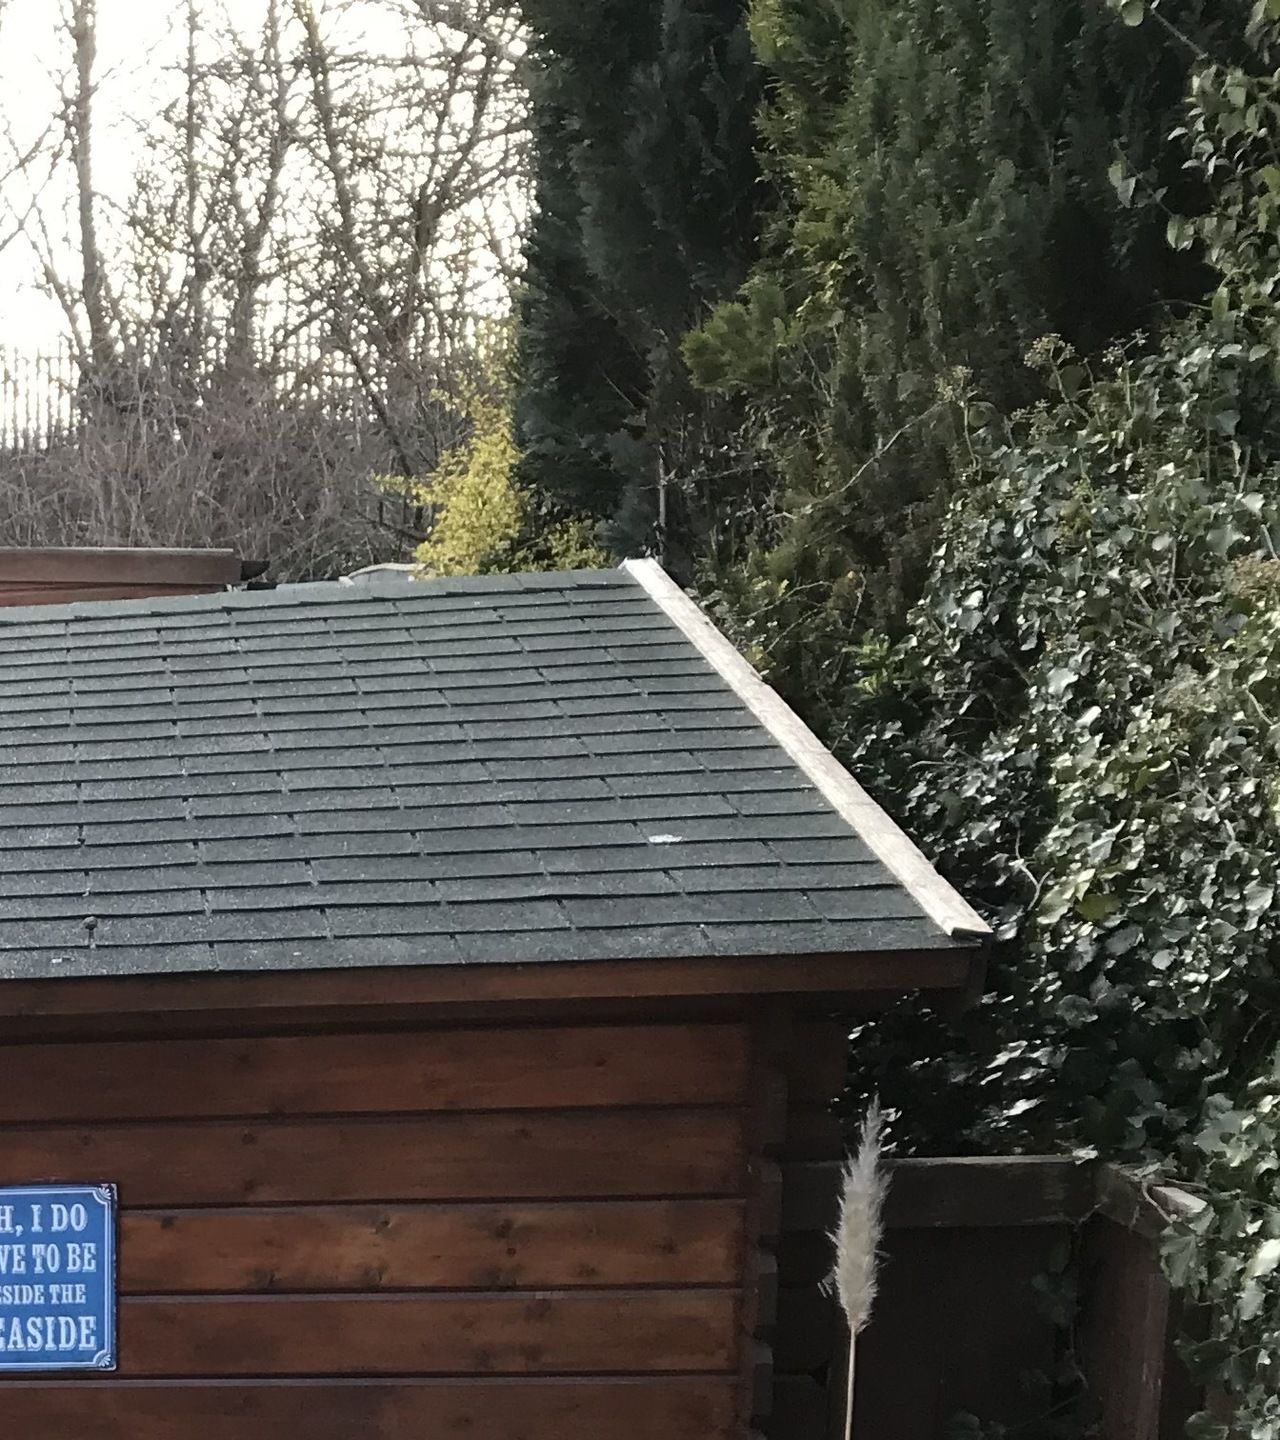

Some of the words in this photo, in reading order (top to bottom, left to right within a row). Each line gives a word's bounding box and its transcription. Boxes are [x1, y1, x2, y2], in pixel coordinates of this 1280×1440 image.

[31, 1204, 43, 1232] I
[51, 1203, 88, 1232] DO
[32, 1243, 60, 1274] TO
[67, 1242, 97, 1273] BE
[49, 1284, 86, 1305] THE
